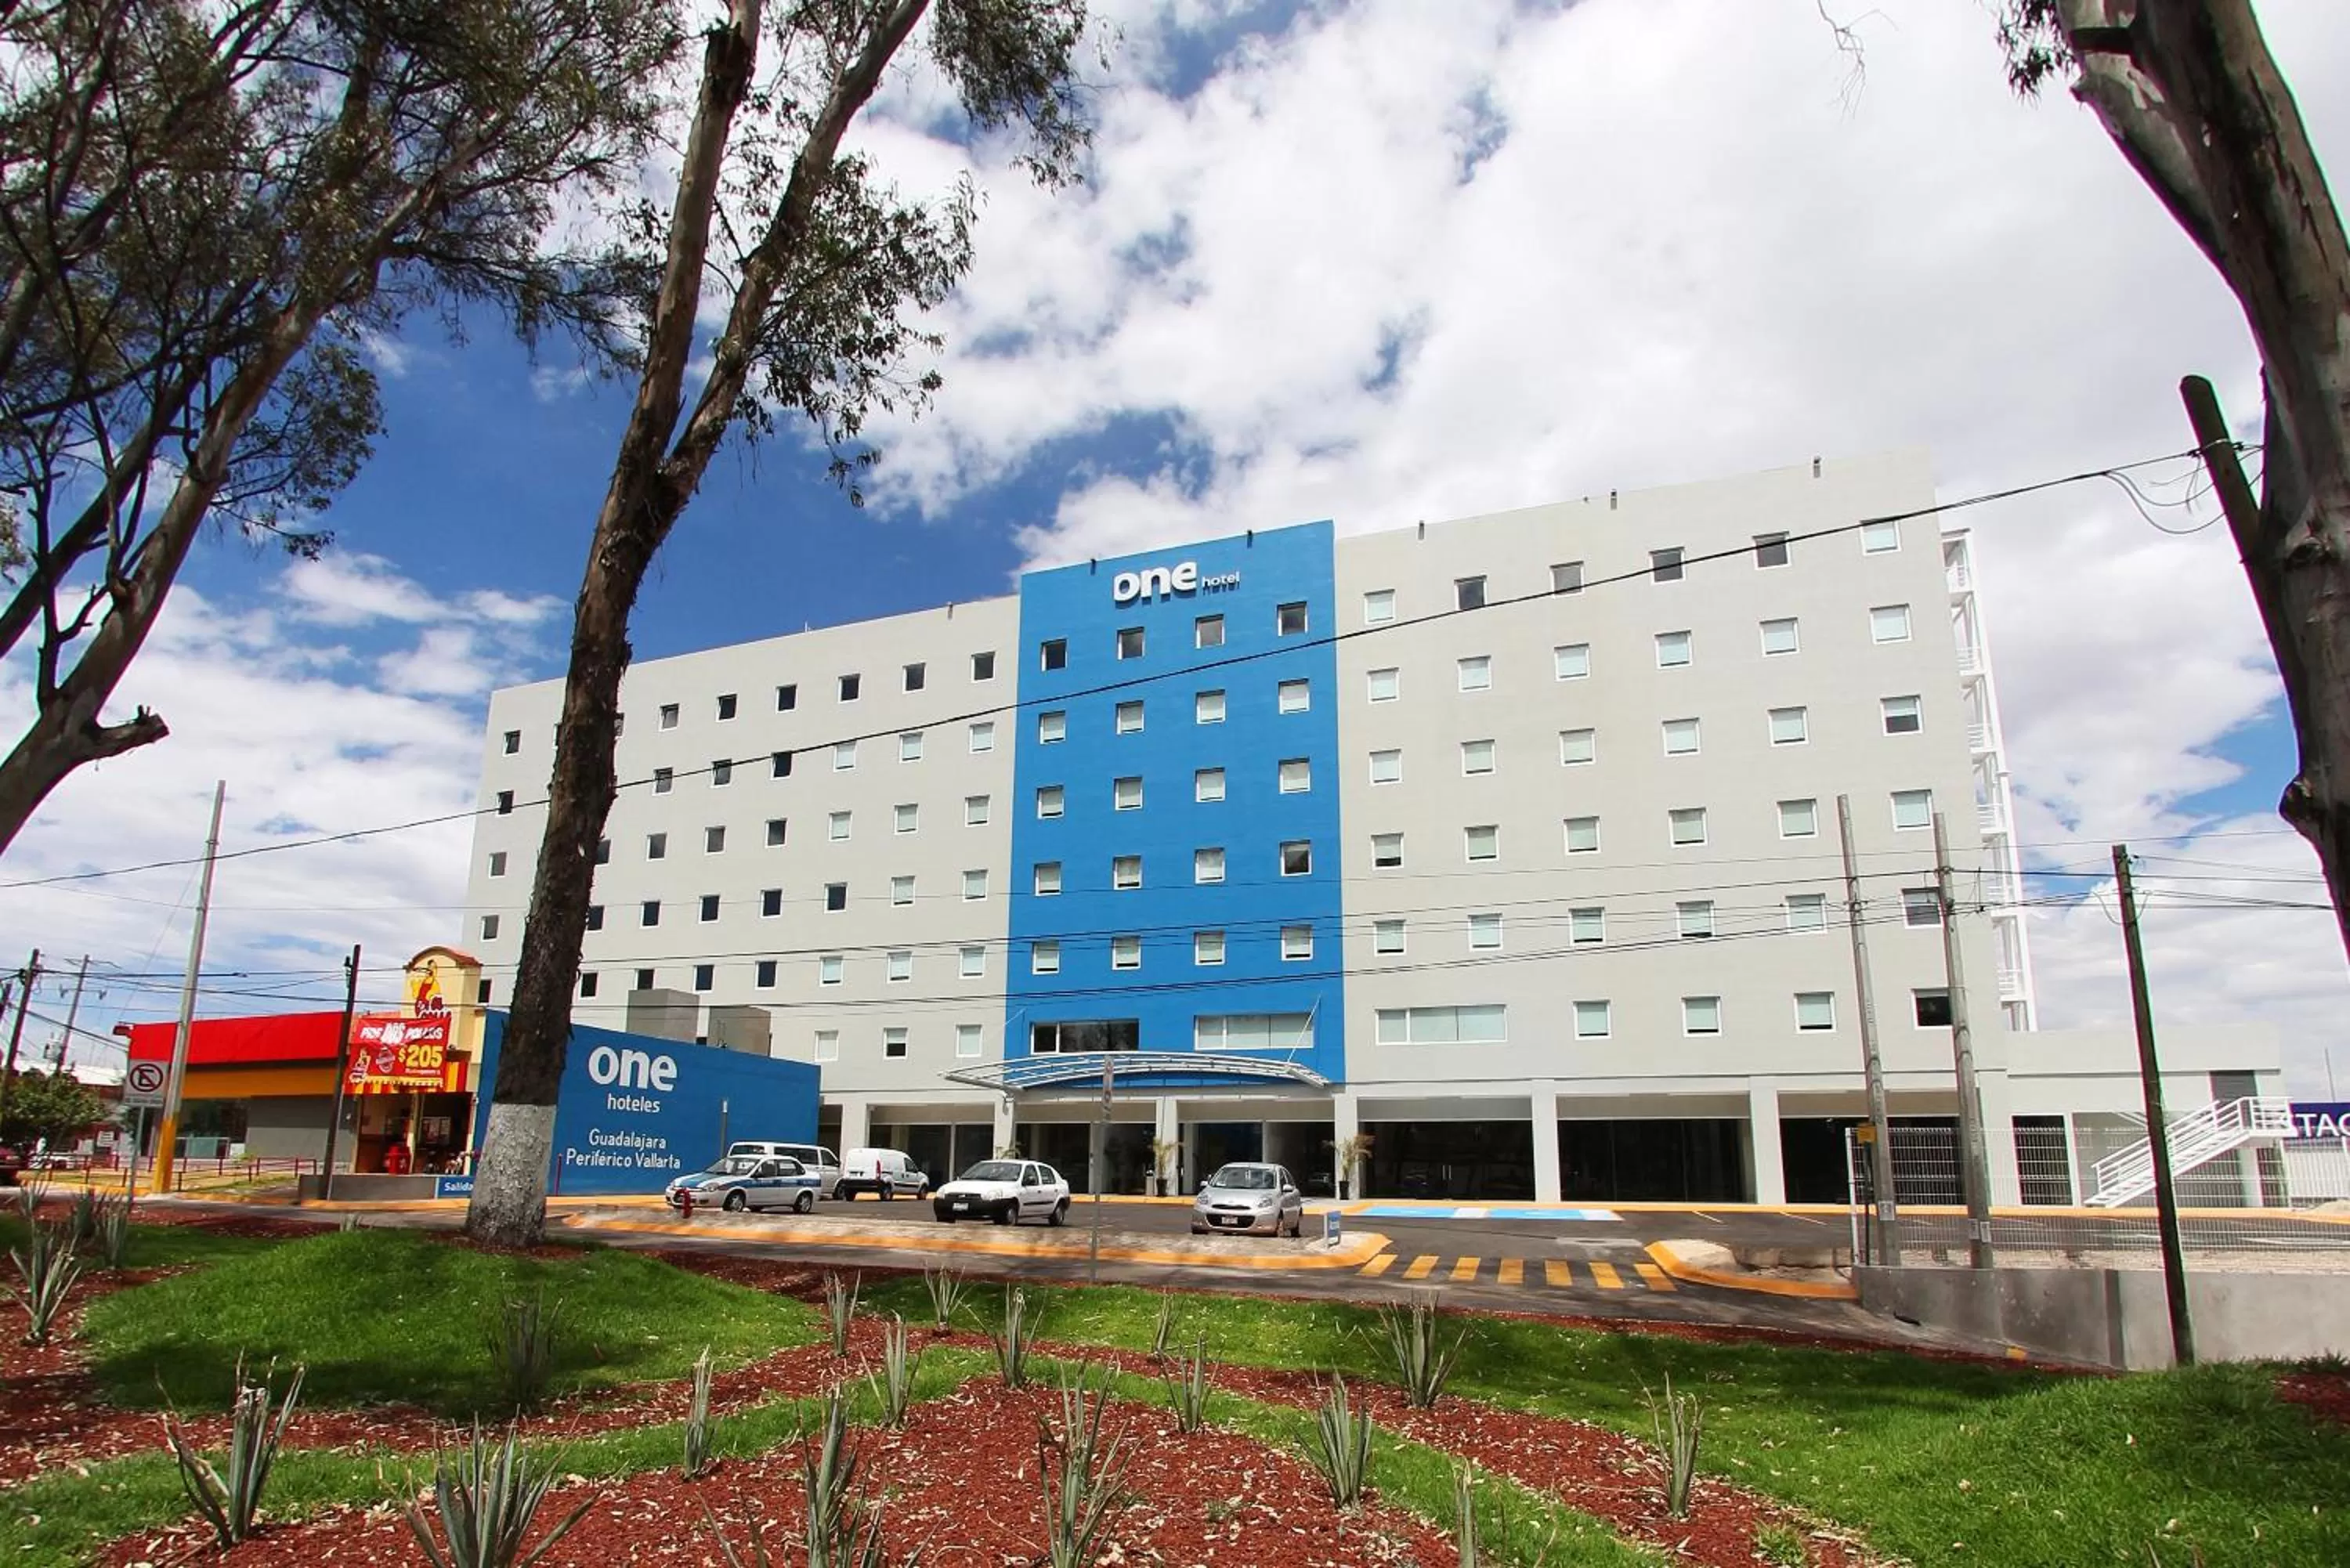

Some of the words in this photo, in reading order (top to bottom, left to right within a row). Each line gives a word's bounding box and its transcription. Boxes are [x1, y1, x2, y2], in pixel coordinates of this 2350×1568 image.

[1113, 562, 1198, 602] one
[1202, 571, 1241, 587] hotel
[398, 1044, 444, 1068] $205
[588, 1046, 678, 1092] one
[607, 1093, 660, 1113] hoteles
[588, 1128, 667, 1151] Guadalajara
[566, 1147, 632, 1167] Periférico
[635, 1152, 681, 1169] Vallarta
[444, 1181, 474, 1191] Salida
